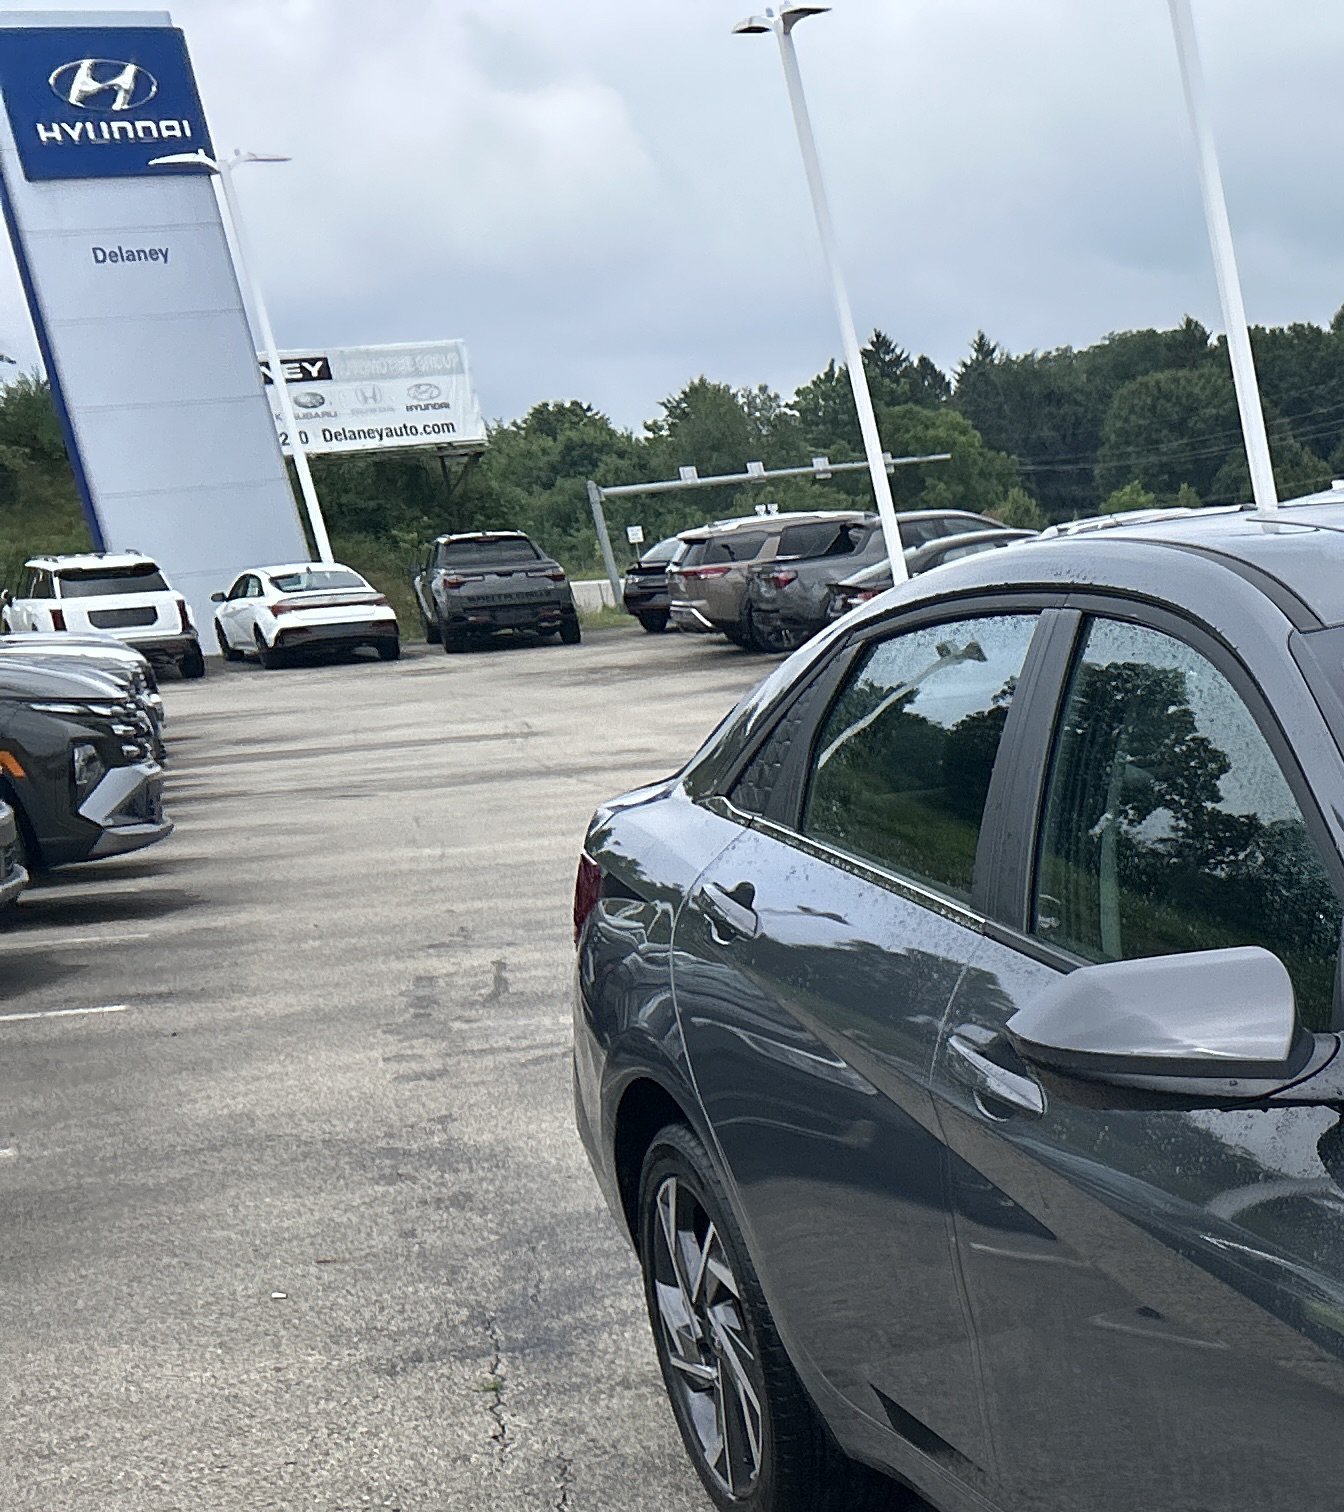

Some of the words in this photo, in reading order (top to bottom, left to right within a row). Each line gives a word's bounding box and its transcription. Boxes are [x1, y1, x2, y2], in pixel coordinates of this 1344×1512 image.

[36, 120, 192, 142] HYUNDAI
[91, 246, 169, 264] Delaney
[322, 421, 457, 443] Delaneyauto.com
